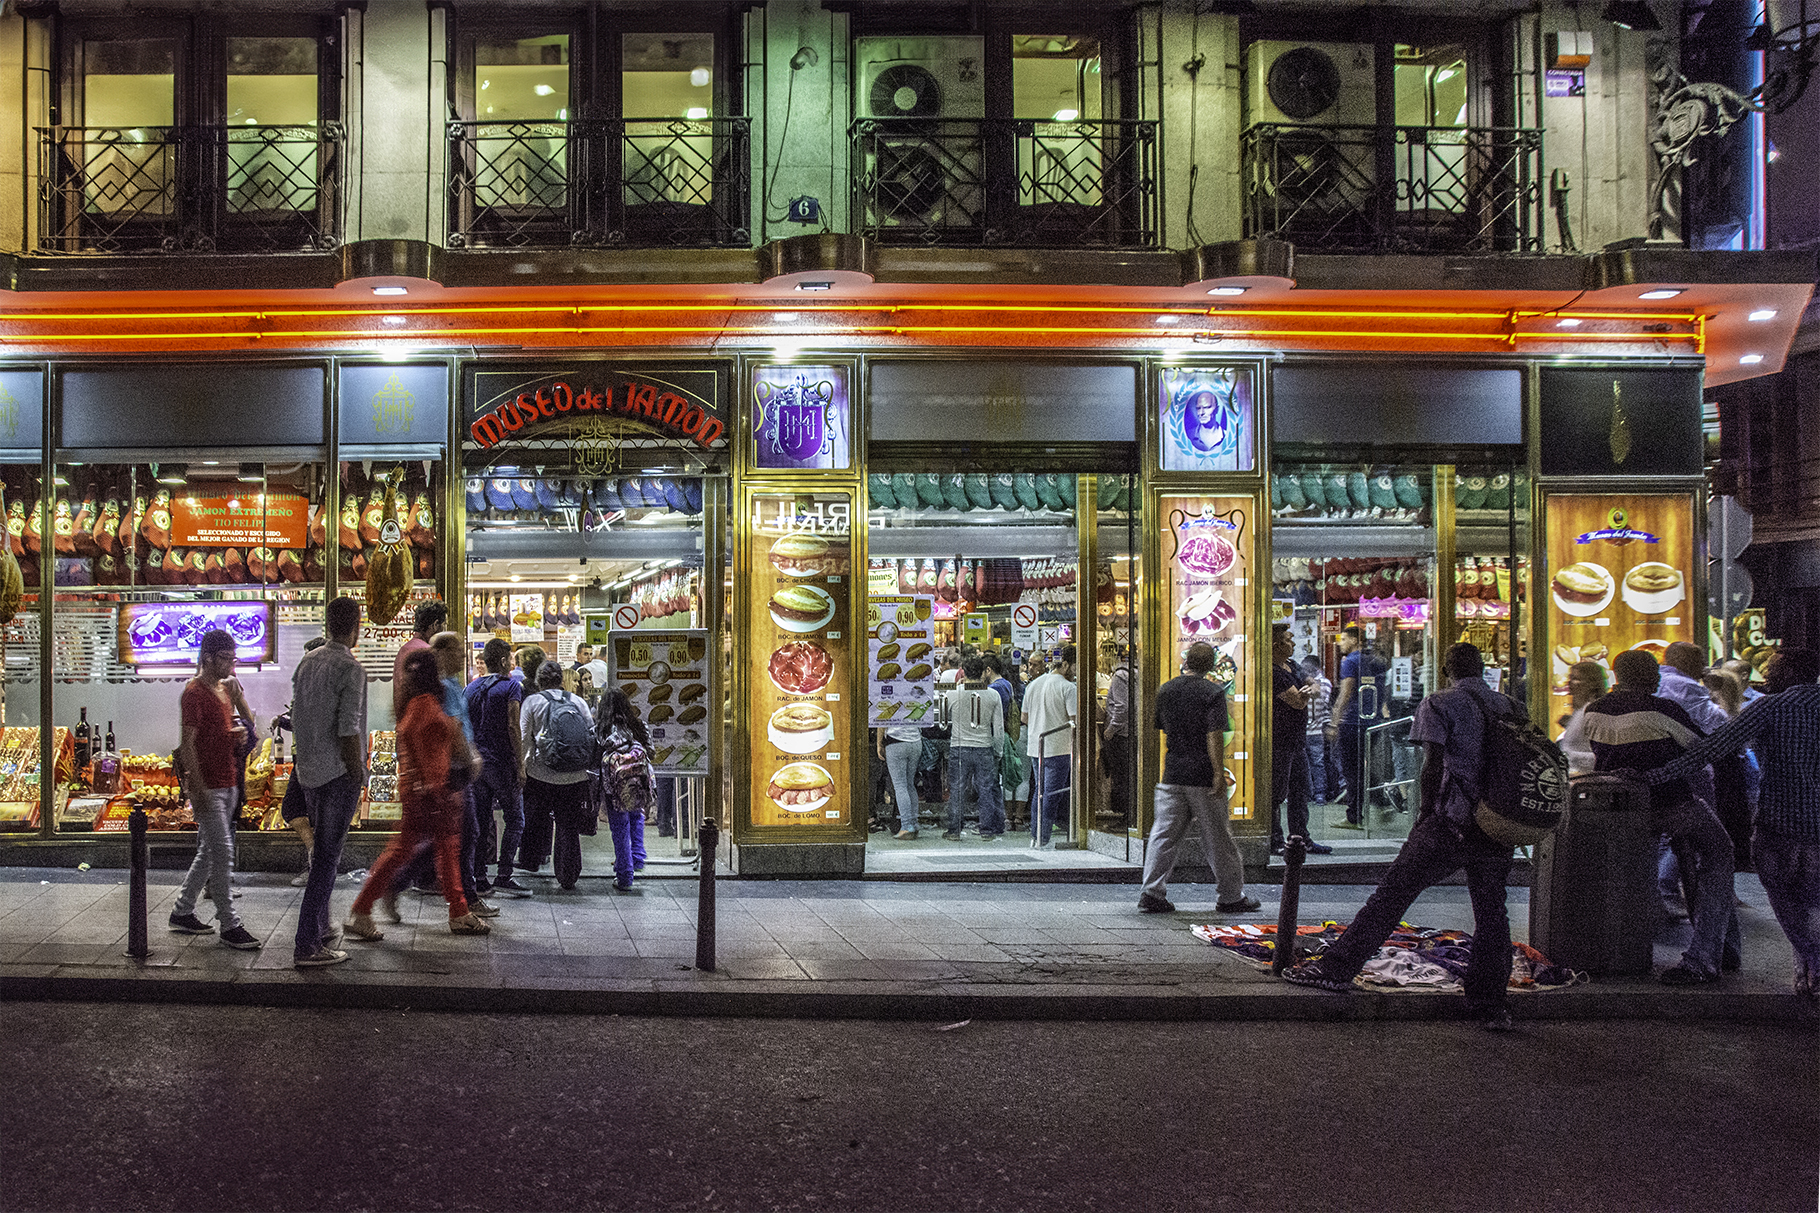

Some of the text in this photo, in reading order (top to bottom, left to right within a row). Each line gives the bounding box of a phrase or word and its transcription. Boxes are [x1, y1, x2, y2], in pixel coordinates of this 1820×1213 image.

[799, 200, 810, 216] 6
[471, 382, 573, 449] MUSEO
[575, 385, 613, 410] del
[189, 507, 294, 517] JAMON EXTREMEÑO
[214, 518, 231, 527] TIO
[897, 611, 914, 625] 0,90
[364, 627, 398, 639] 27,00
[630, 649, 648, 662] 0,50
[669, 650, 687, 664] 0,90
